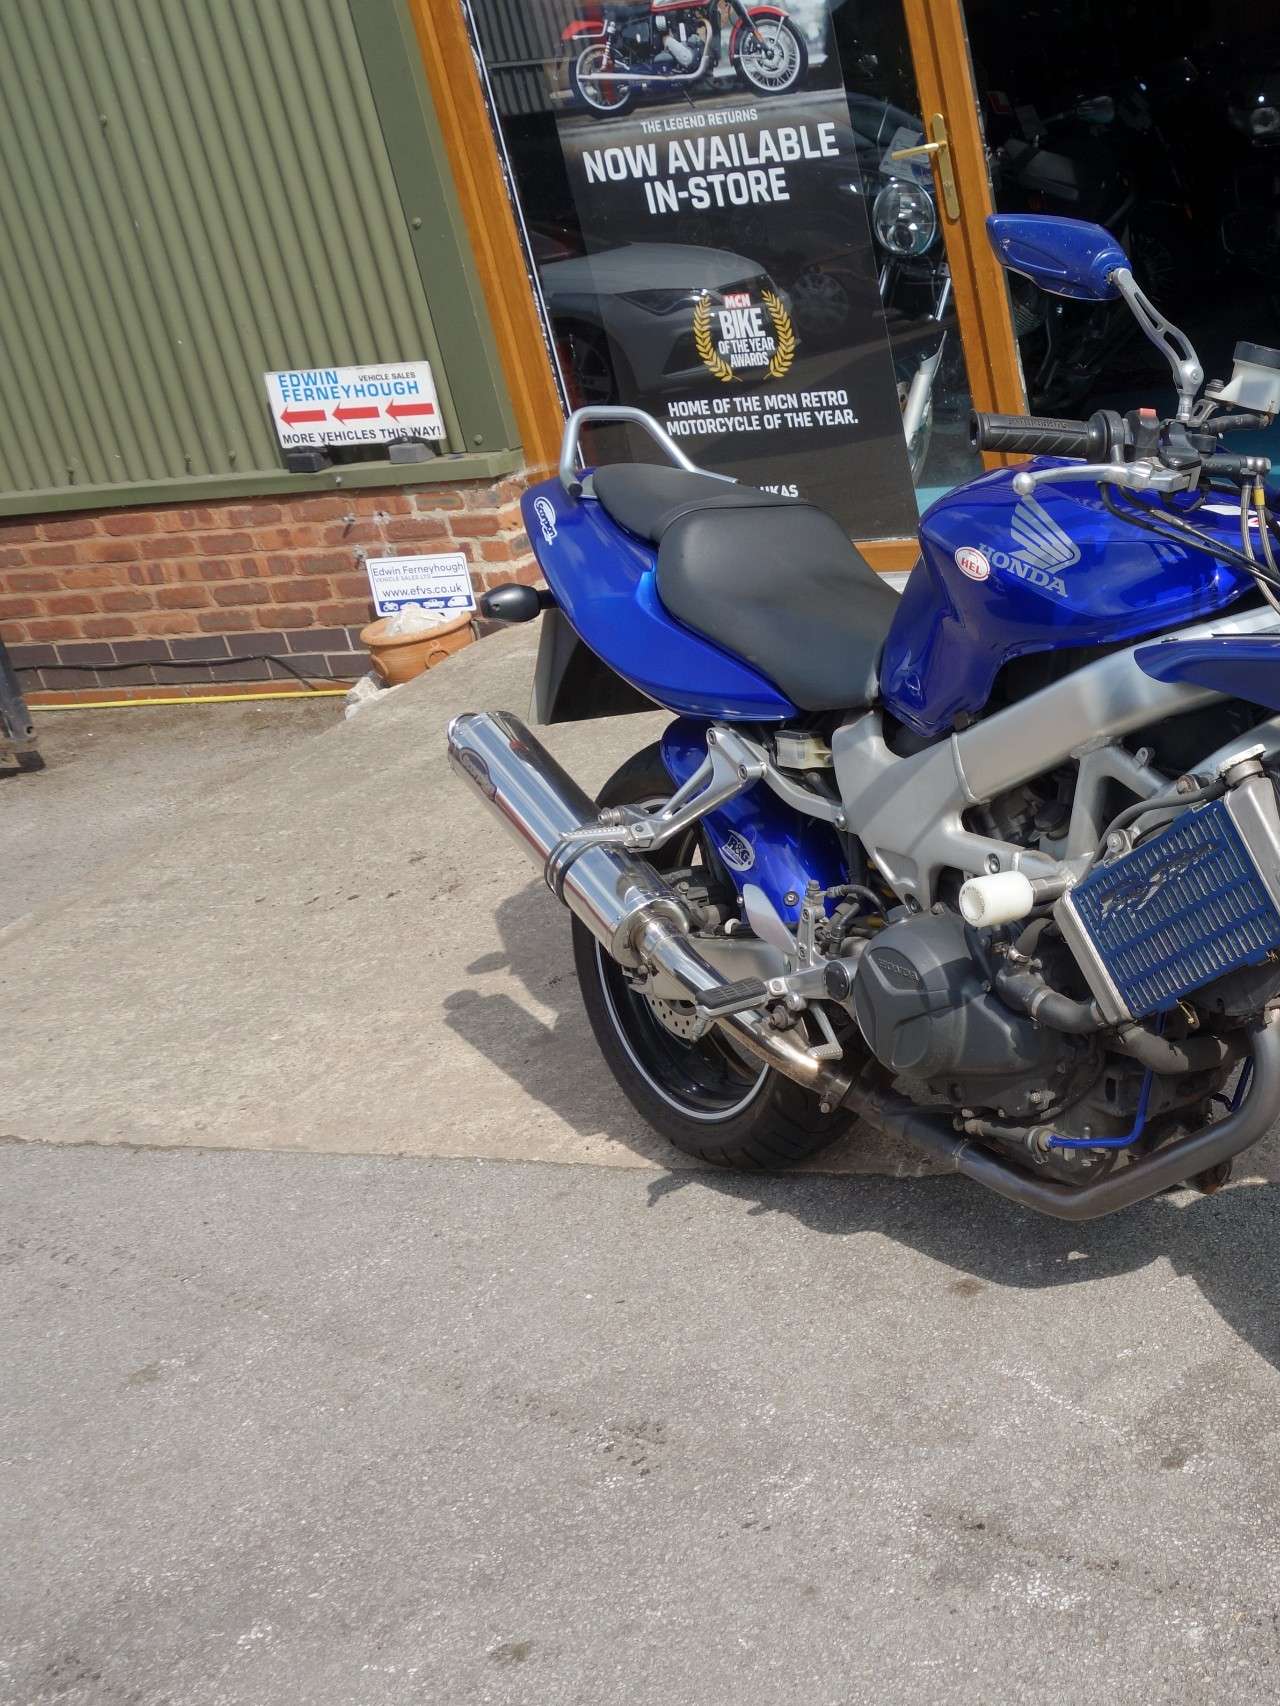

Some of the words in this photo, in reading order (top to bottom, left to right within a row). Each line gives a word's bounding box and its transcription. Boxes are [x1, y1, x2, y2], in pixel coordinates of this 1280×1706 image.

[641, 120, 662, 134] THE
[664, 115, 705, 131] LEGEND
[707, 108, 758, 125] RETURNS
[582, 143, 658, 183] NOW
[668, 122, 840, 174] AVAILABLE
[644, 167, 790, 214] IN-STORE
[724, 293, 751, 308] MCN
[718, 307, 766, 339] BIKE
[718, 340, 731, 354] OF
[730, 338, 751, 353] THE
[750, 337, 775, 352] YEAR
[730, 352, 769, 368] AWARDS
[278, 371, 338, 388] EDWIN
[358, 373, 388, 382] VEHICLE
[391, 371, 416, 379] SALES
[281, 381, 420, 403] FERNEYHOUGH
[667, 401, 711, 417] HOME
[713, 398, 731, 414] OF
[732, 395, 761, 413] THE
[764, 393, 798, 411] MCN
[800, 390, 848, 408] RETRO
[666, 415, 761, 436] MOTORCYCLE
[763, 413, 782, 430] OF
[784, 411, 813, 428] THE
[814, 409, 859, 426] YEAR.
[282, 433, 316, 445] MORE
[317, 429, 377, 443] VEHICLES
[379, 427, 408, 438] THIS
[410, 425, 442, 437] WAY!
[373, 566, 401, 577] Edwin
[402, 562, 464, 575] Ferneyhough
[961, 557, 981, 576] HEL
[979, 543, 1068, 598] HONDA
[383, 584, 462, 598] www.efvs.co.uk
